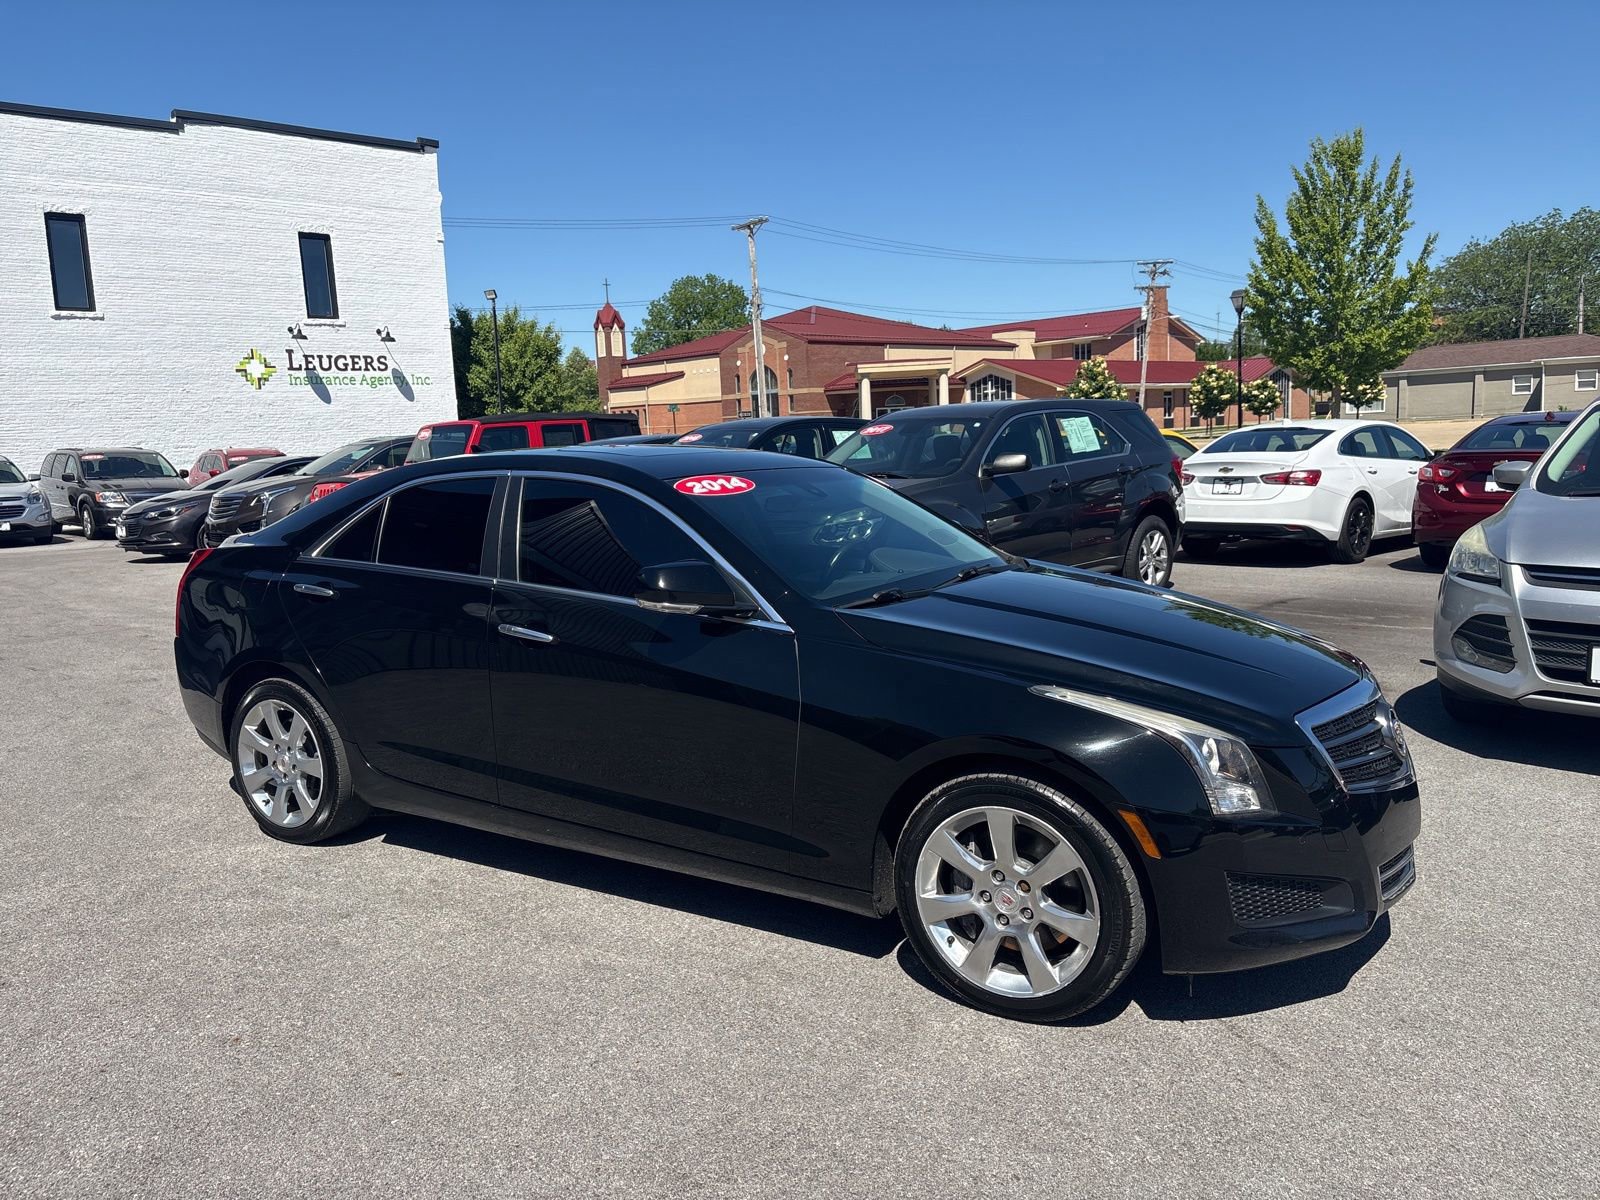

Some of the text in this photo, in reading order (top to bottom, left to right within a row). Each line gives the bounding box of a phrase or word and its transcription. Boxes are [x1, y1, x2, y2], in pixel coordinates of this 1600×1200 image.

[285, 348, 389, 372] LEUGERS
[288, 373, 357, 386] Insurance
[411, 374, 433, 386] Inc.
[685, 477, 748, 494] 2014
